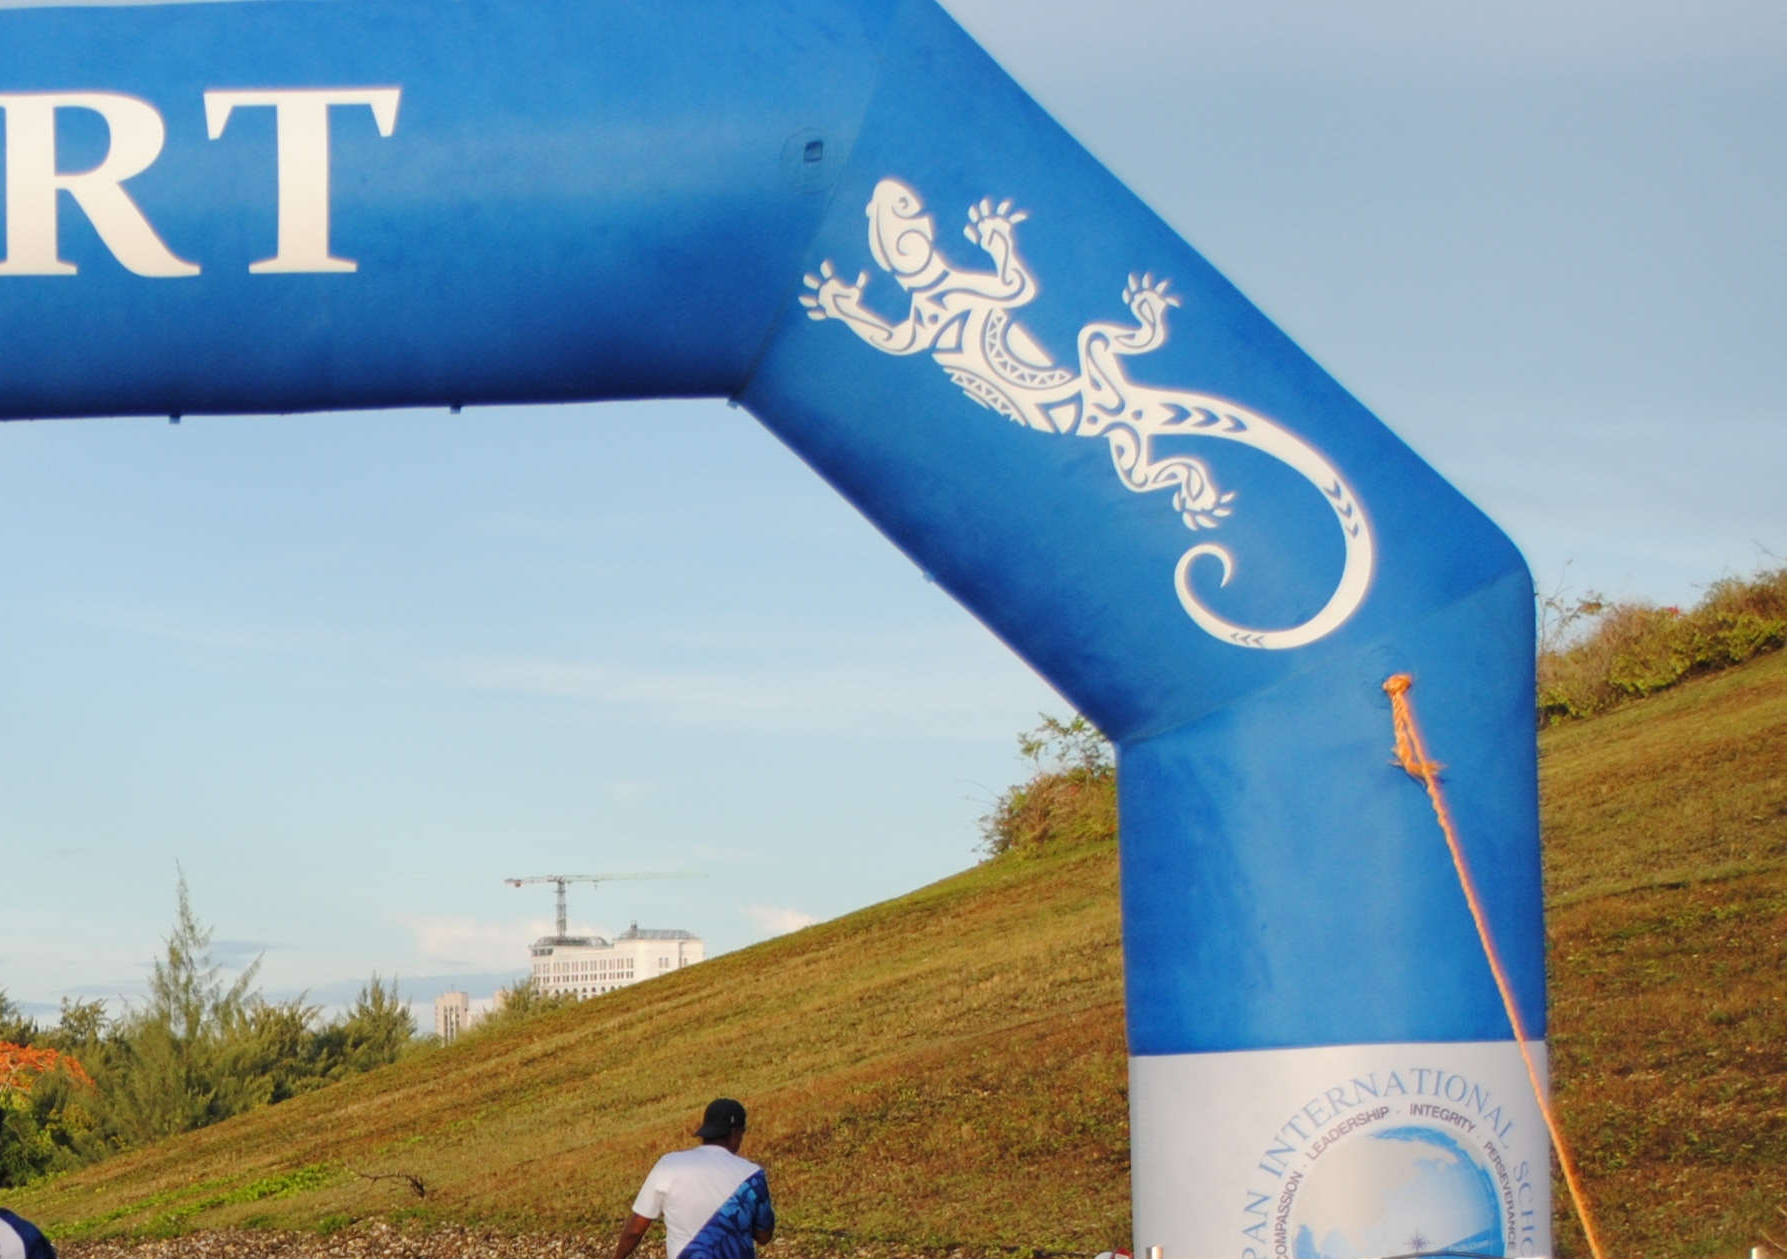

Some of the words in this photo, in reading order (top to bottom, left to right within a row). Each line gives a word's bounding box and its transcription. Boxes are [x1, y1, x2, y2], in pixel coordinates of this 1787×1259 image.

[1258, 1068, 1513, 1179] INTERNATIONAL
[1513, 1160, 1535, 1259] SCHO
[1305, 1106, 1391, 1161] LEADERSHIP
[1409, 1103, 1477, 1134] INTEGRITY
[1483, 1141, 1516, 1251] PERSEVERANCE
